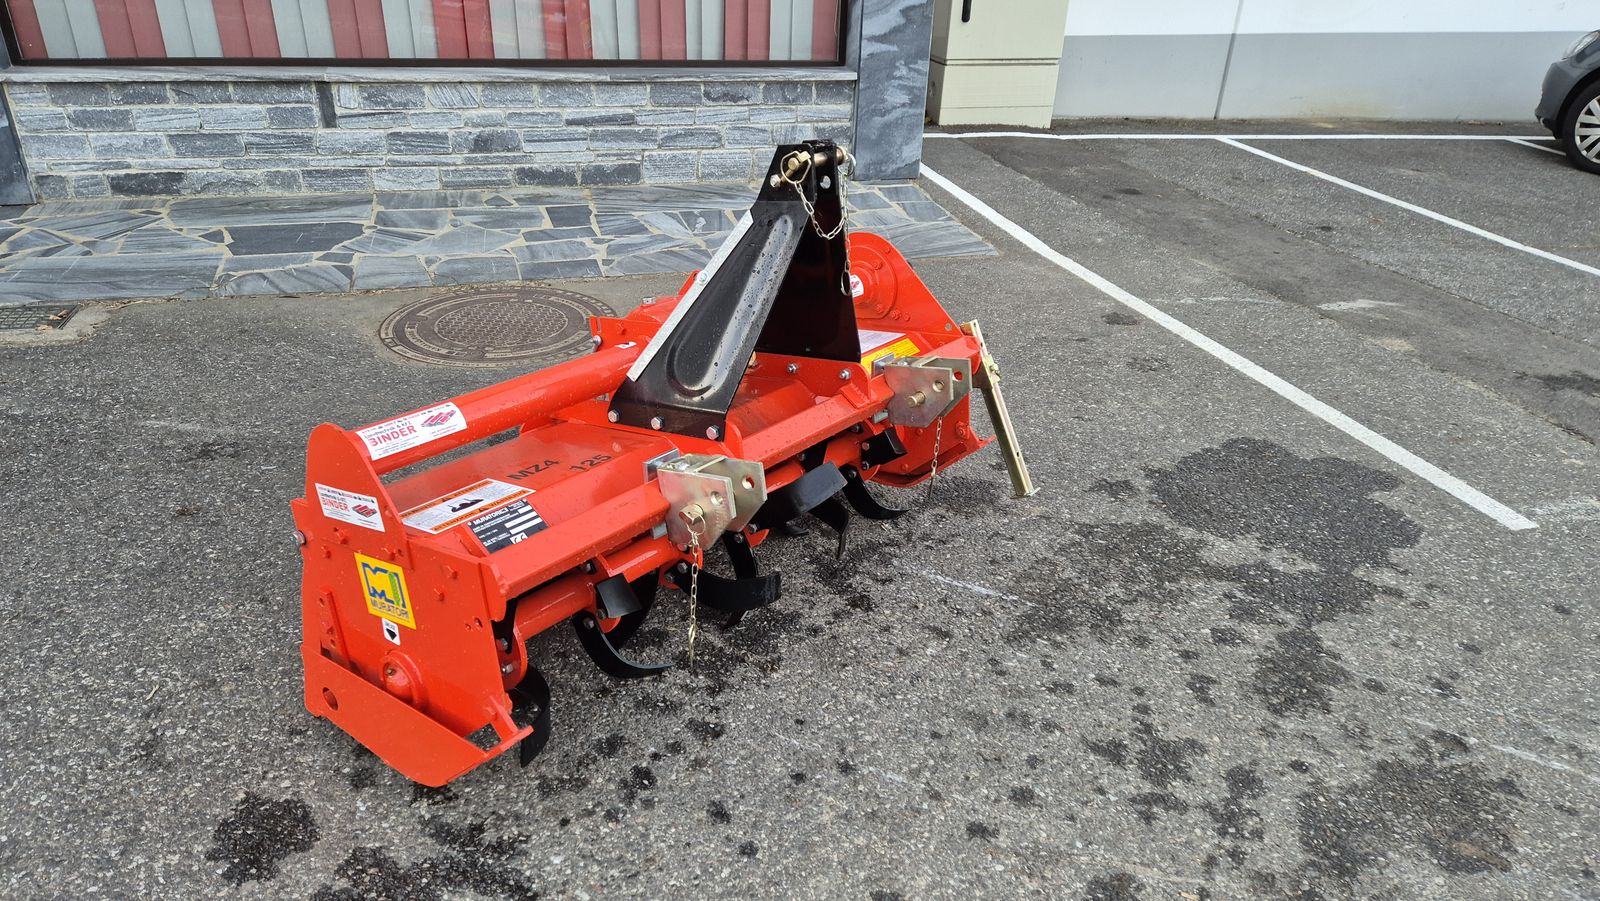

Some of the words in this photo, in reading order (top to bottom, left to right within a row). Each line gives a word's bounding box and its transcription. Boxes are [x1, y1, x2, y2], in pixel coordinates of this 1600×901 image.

[369, 425, 417, 447] BINDER
[506, 459, 559, 480] MZ4
[569, 454, 612, 472] 125
